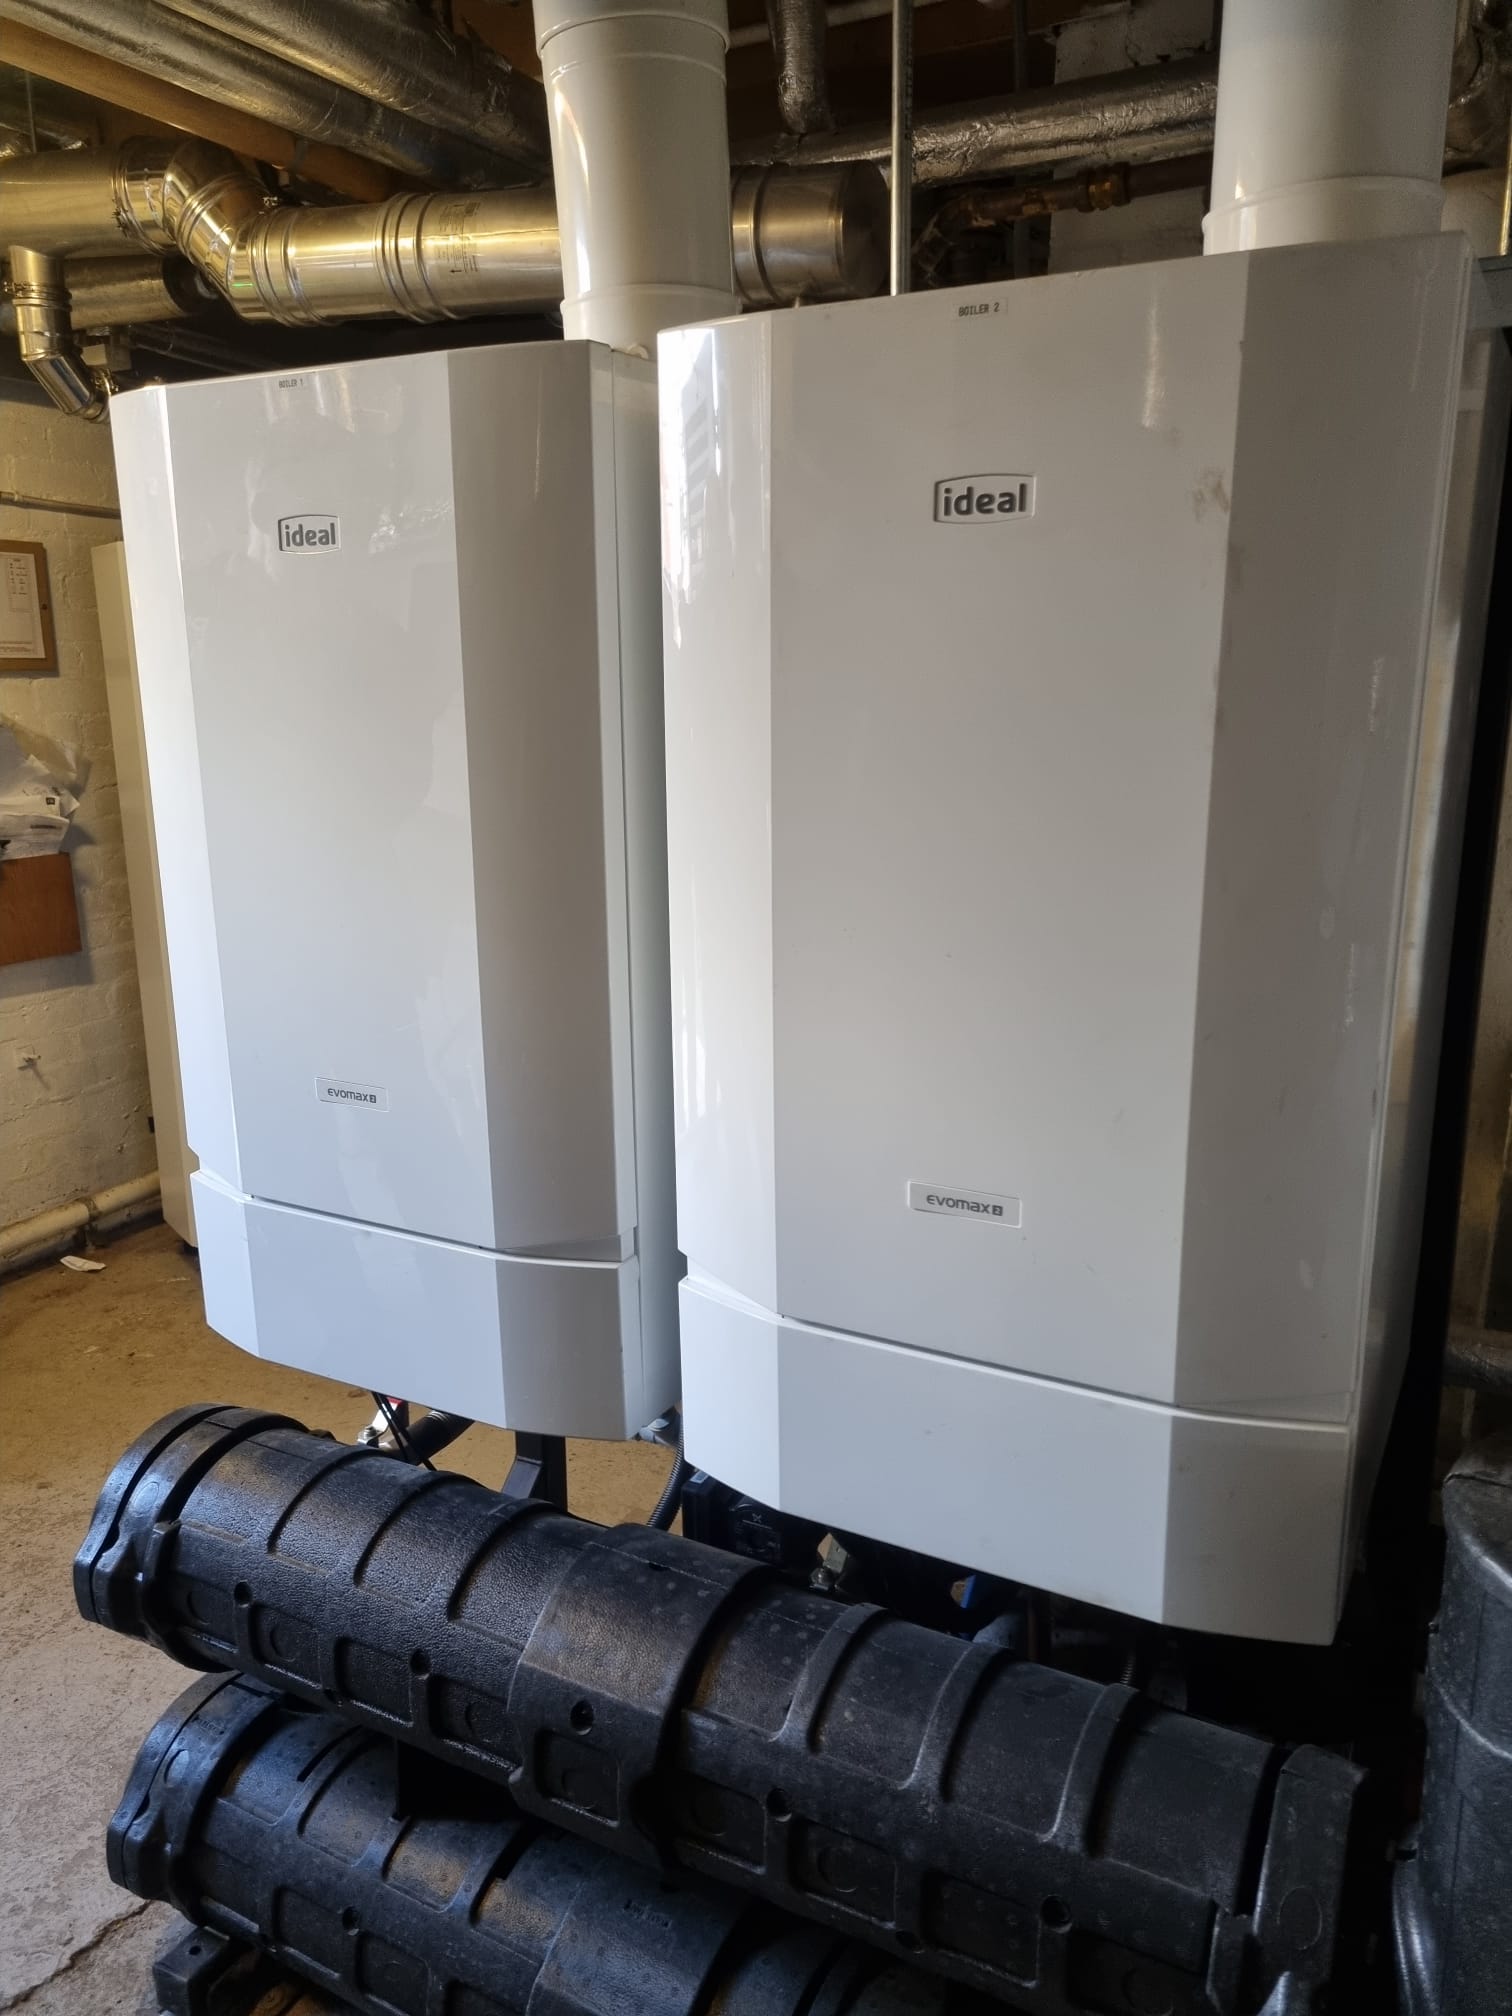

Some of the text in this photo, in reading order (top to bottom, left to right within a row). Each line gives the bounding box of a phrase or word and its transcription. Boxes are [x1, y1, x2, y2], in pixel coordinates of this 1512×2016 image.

[958, 302, 1000, 317] BOILER 2
[943, 483, 1027, 516] ideal
[284, 522, 336, 547] ideal
